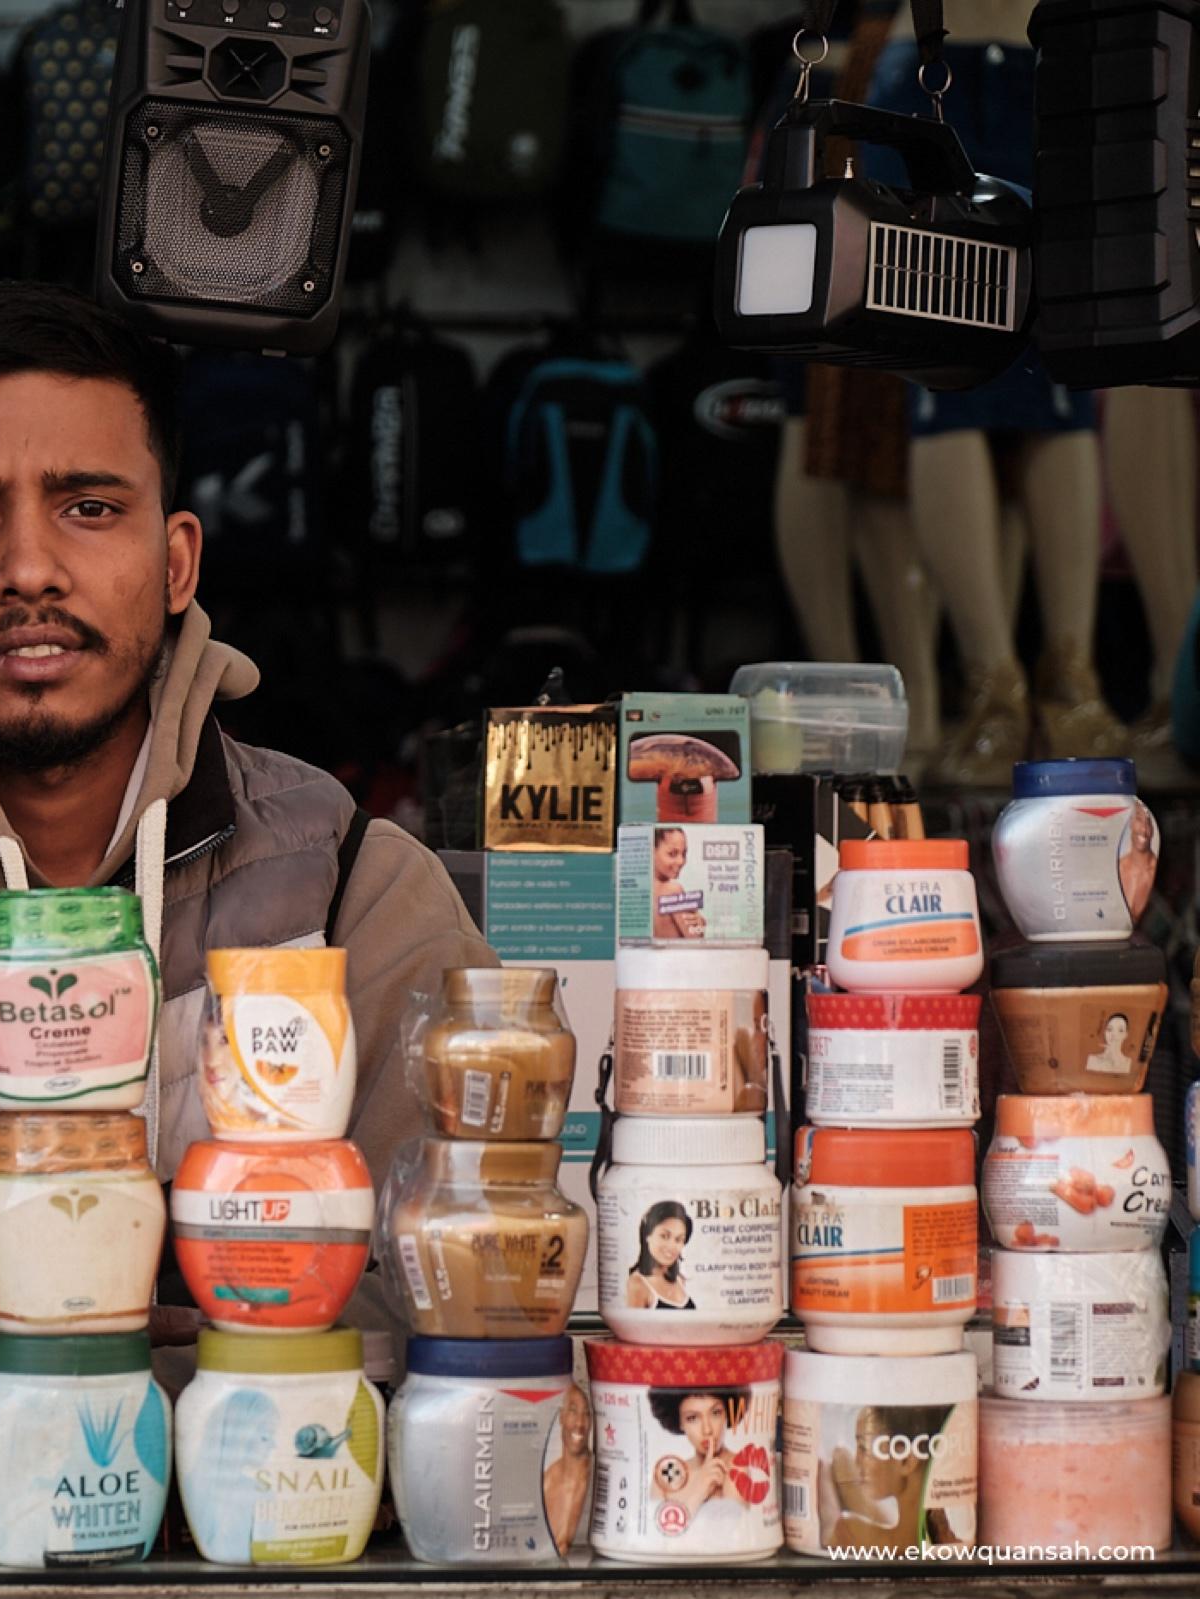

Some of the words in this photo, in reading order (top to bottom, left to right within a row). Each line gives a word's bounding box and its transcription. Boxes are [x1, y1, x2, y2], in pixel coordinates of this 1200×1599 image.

[501, 784, 603, 821] KYLIE
[744, 831, 759, 889] perfect
[1048, 810, 1067, 921] CLAIRMEN
[717, 881, 739, 893] days
[884, 880, 941, 895] EXTRA
[886, 894, 942, 914] CLAIR
[29, 1025, 92, 1041] Creme
[251, 1026, 297, 1041] PAW
[251, 1040, 298, 1054] PAW
[504, 1232, 541, 1254] WHITE
[797, 1224, 843, 1247] CLAIR
[695, 1263, 747, 1273] CLARIFYING
[255, 1467, 356, 1493] SNAIL
[473, 1390, 496, 1552] CLAIRMEN
[53, 1469, 141, 1499] ALOE
[51, 1499, 142, 1529] WHITEN
